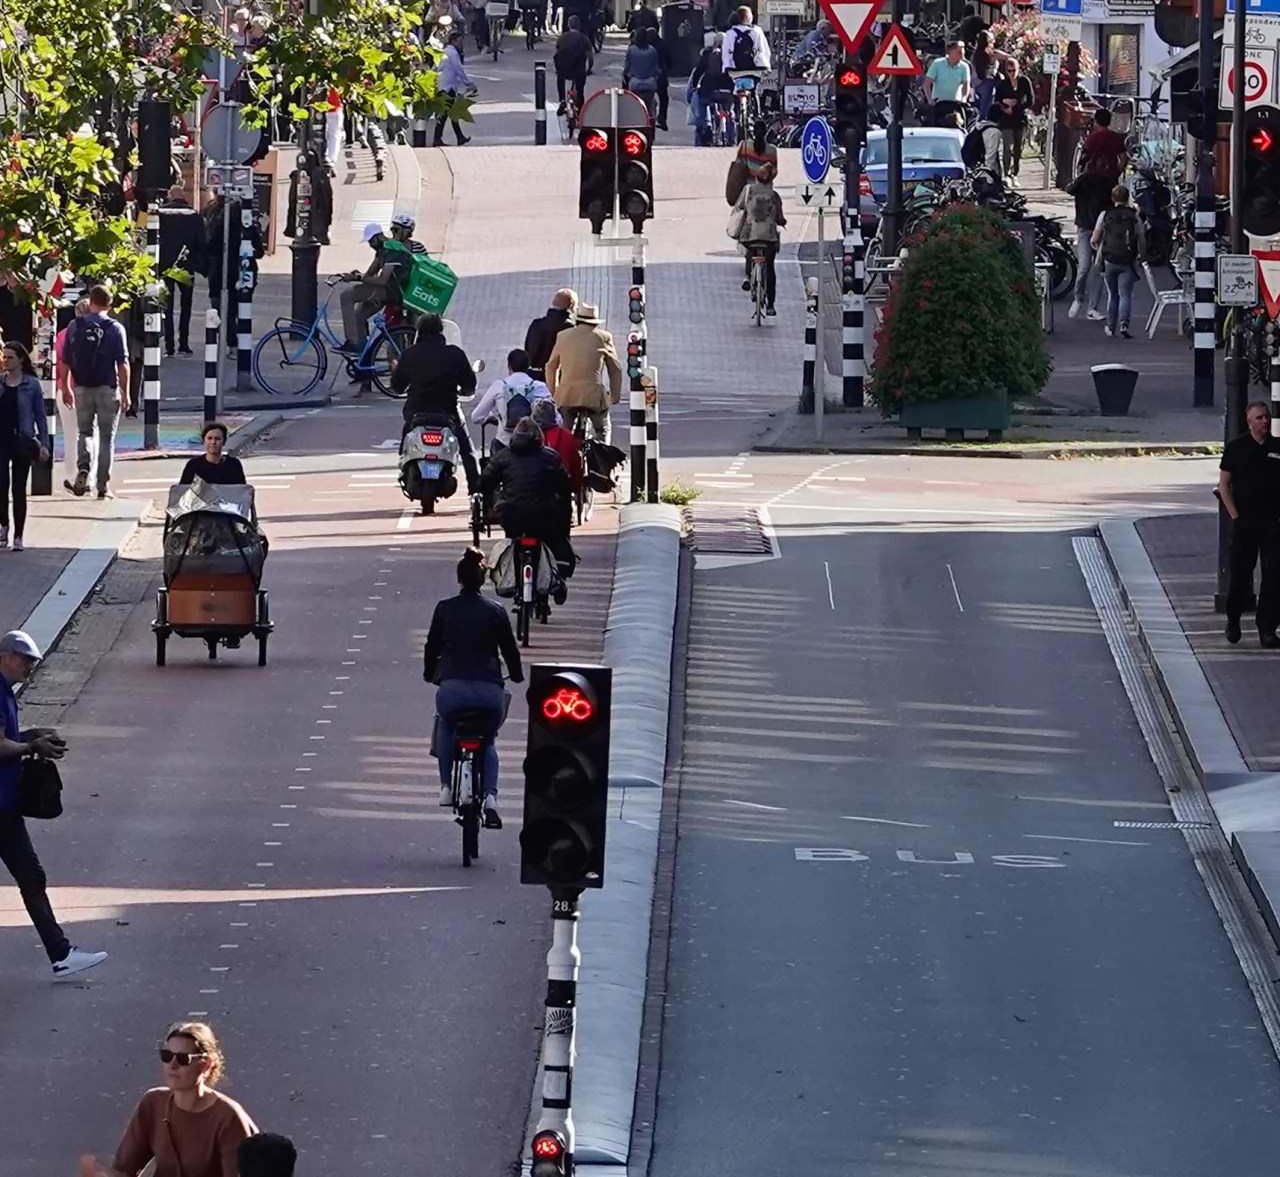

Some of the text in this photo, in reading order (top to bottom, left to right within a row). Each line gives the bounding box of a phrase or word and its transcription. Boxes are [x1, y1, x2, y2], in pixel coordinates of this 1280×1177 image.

[1244, 51, 1262, 59] ONE
[1257, 111, 1269, 119] 1.1
[412, 285, 440, 307] Eats
[793, 846, 1068, 868] BUS
